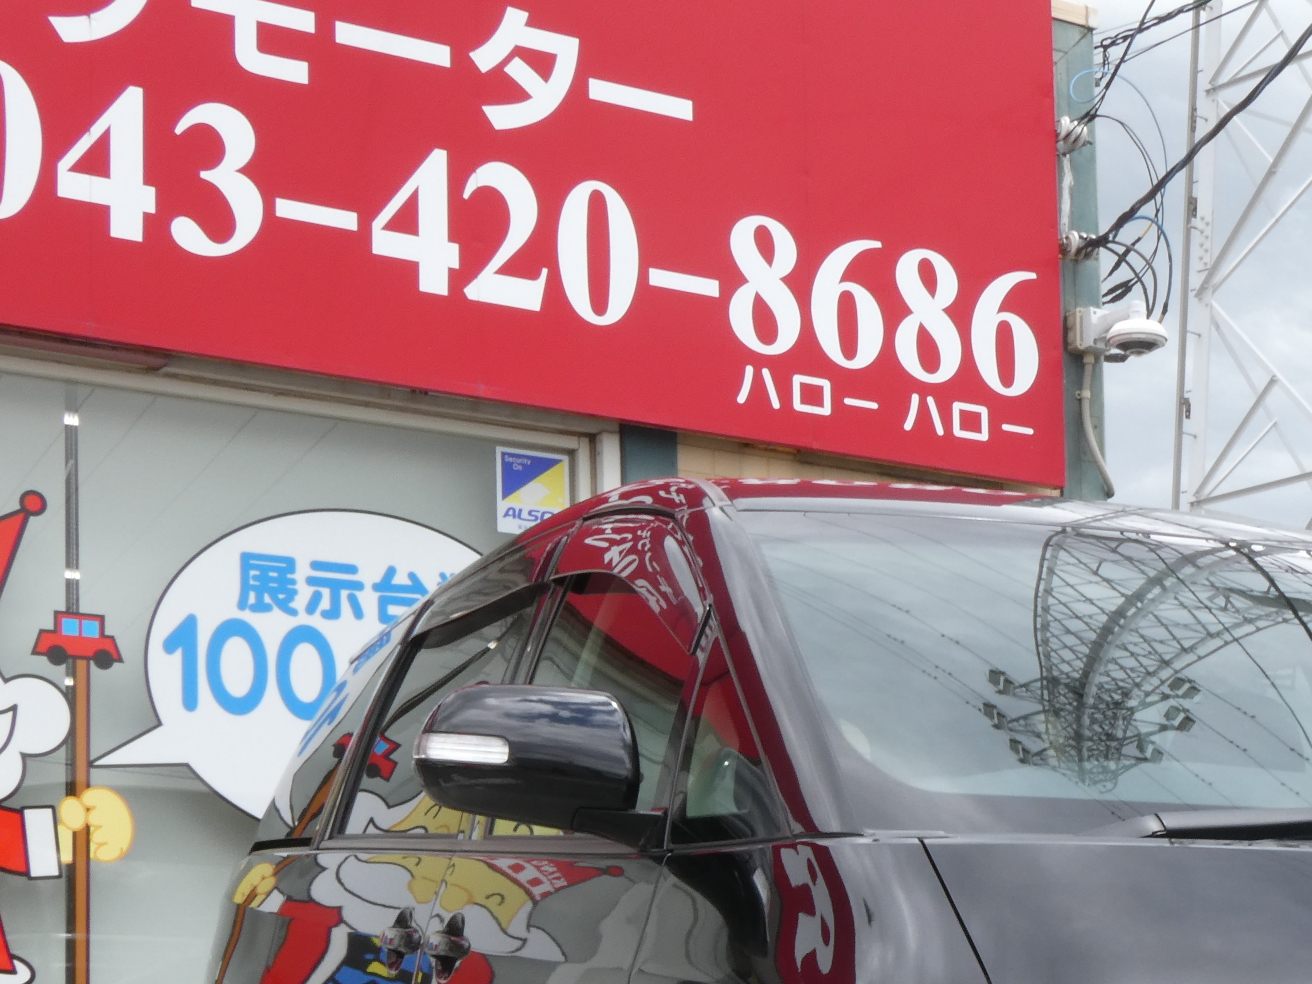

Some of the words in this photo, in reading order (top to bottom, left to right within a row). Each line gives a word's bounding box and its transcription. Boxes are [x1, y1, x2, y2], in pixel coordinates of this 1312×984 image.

[504, 454, 531, 466] Security
[512, 463, 523, 471] On
[237, 551, 455, 625] 展示台
